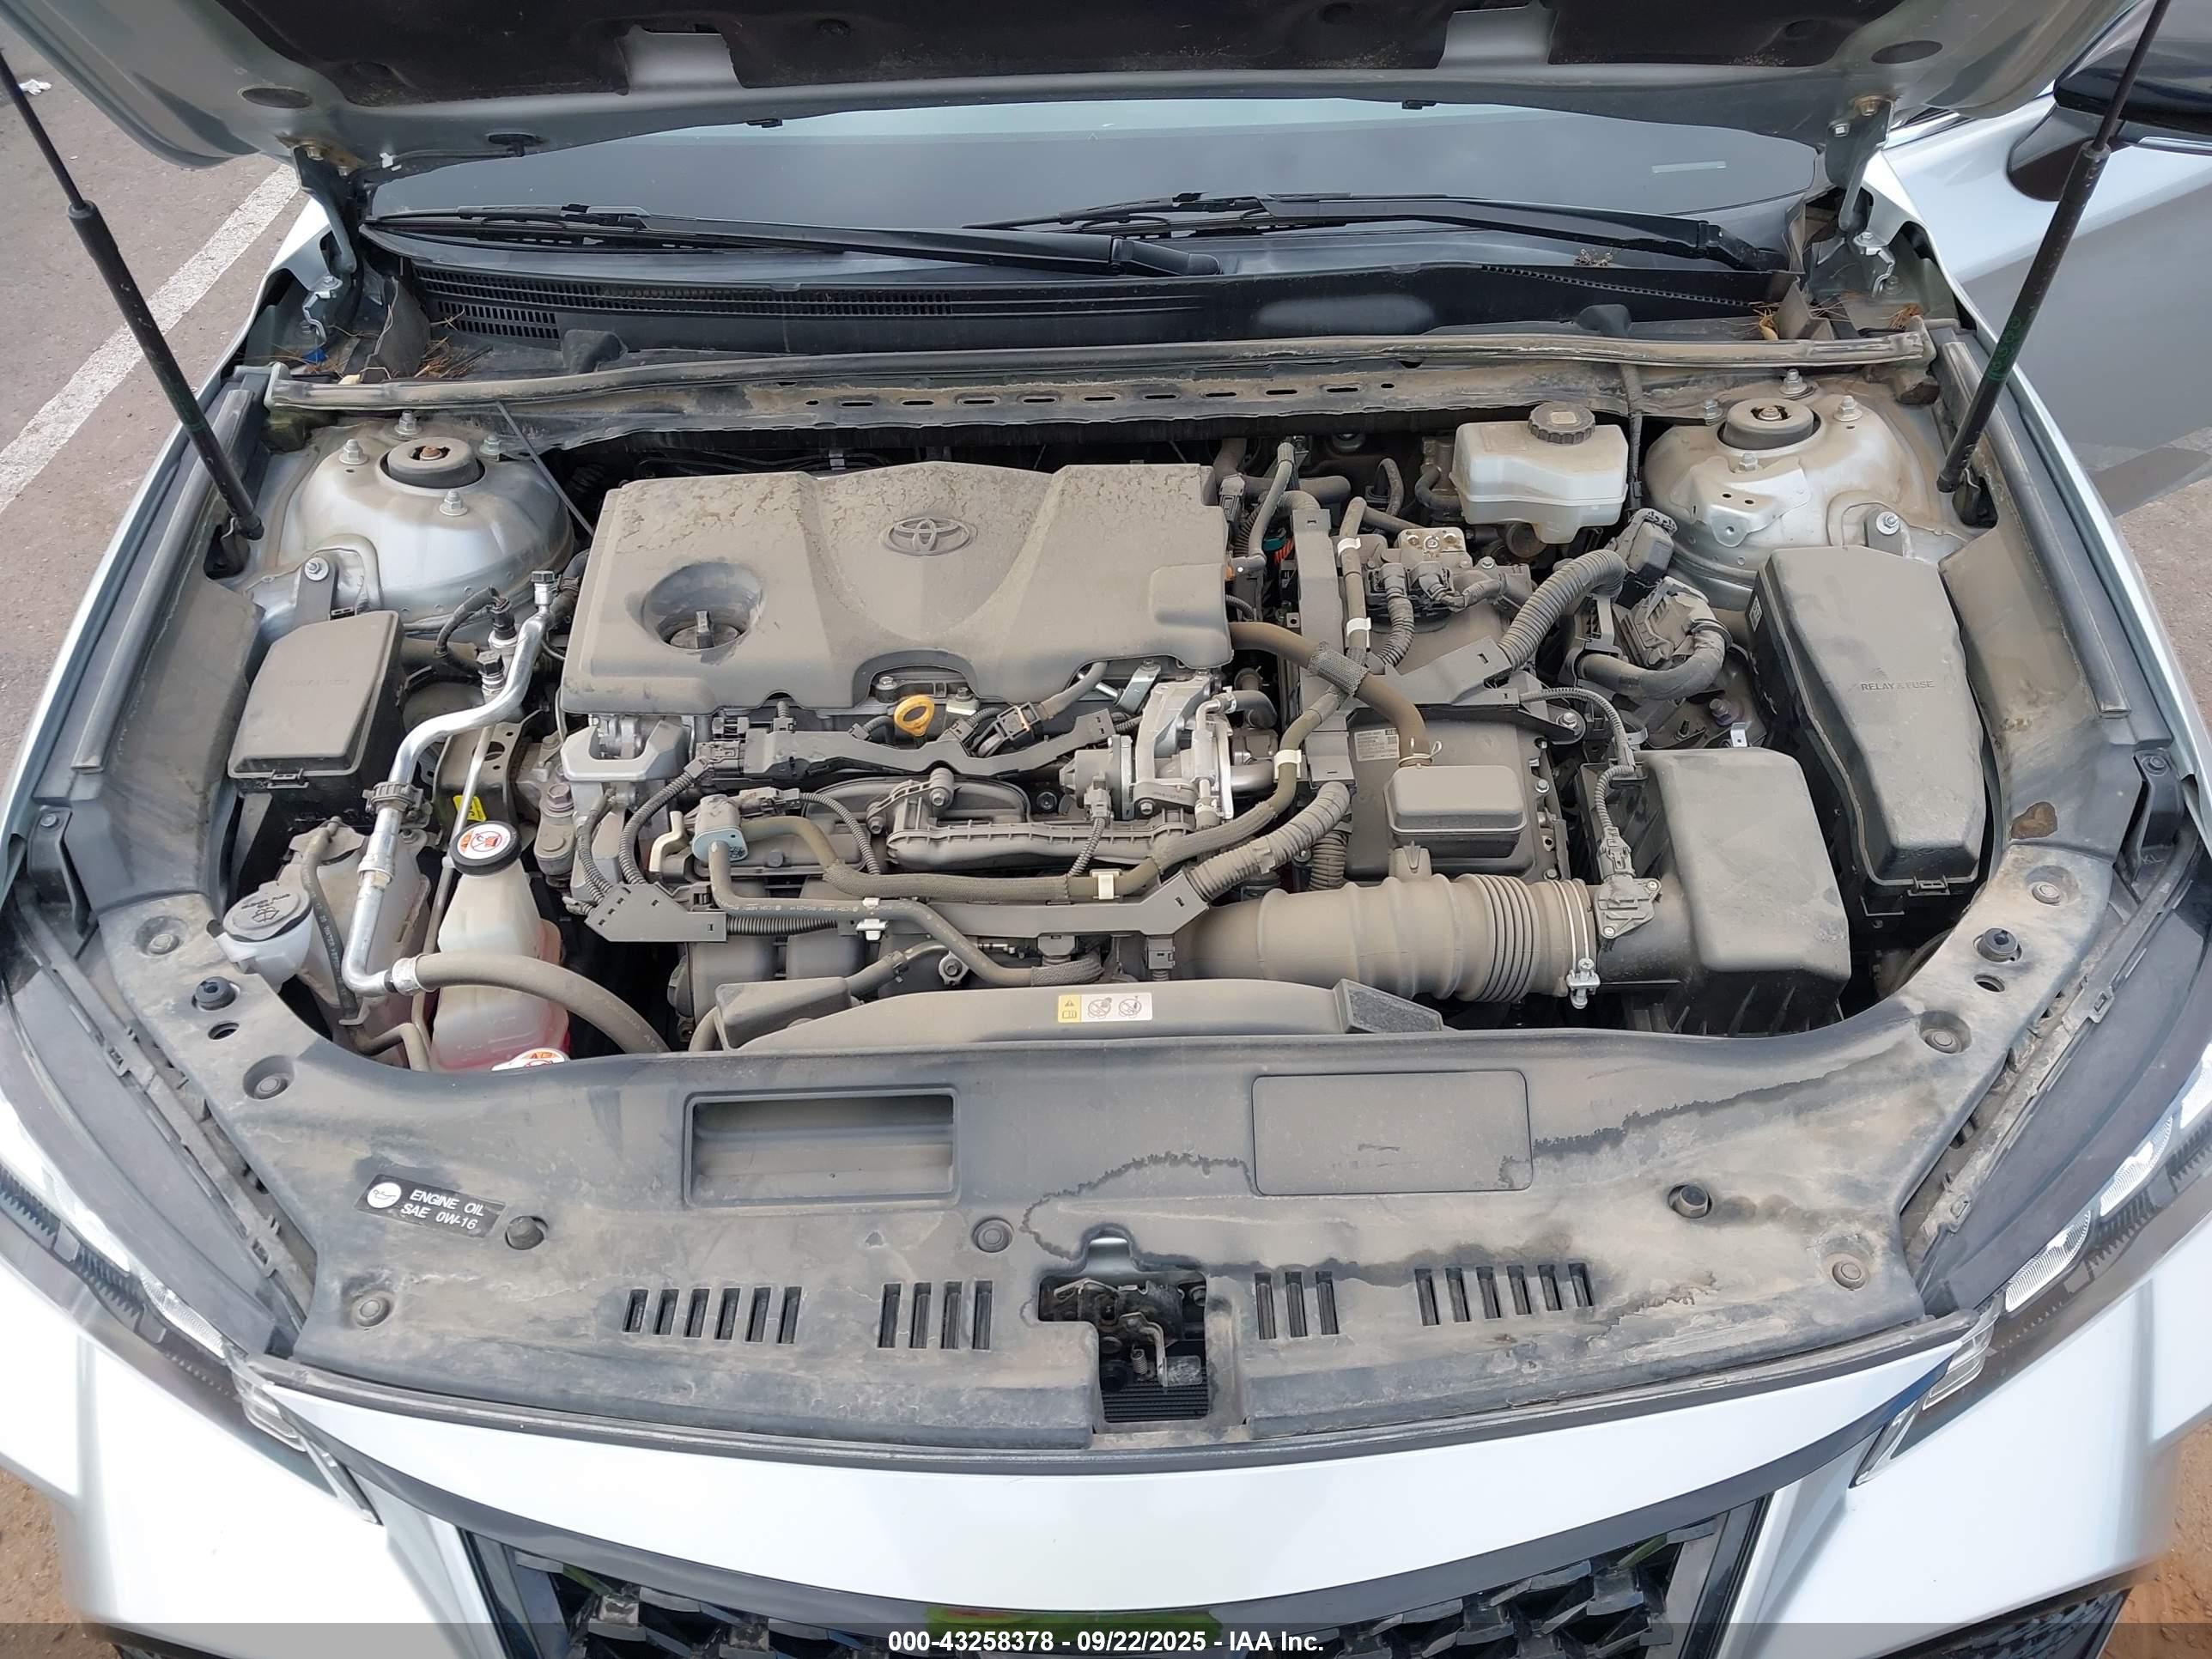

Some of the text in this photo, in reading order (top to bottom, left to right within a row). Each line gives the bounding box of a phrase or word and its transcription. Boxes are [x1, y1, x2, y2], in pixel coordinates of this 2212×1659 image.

[1861, 682, 1894, 690] RELAY
[400, 1203, 477, 1230] SAE 0W-16
[410, 1189, 484, 1217] ENGINE OIL
